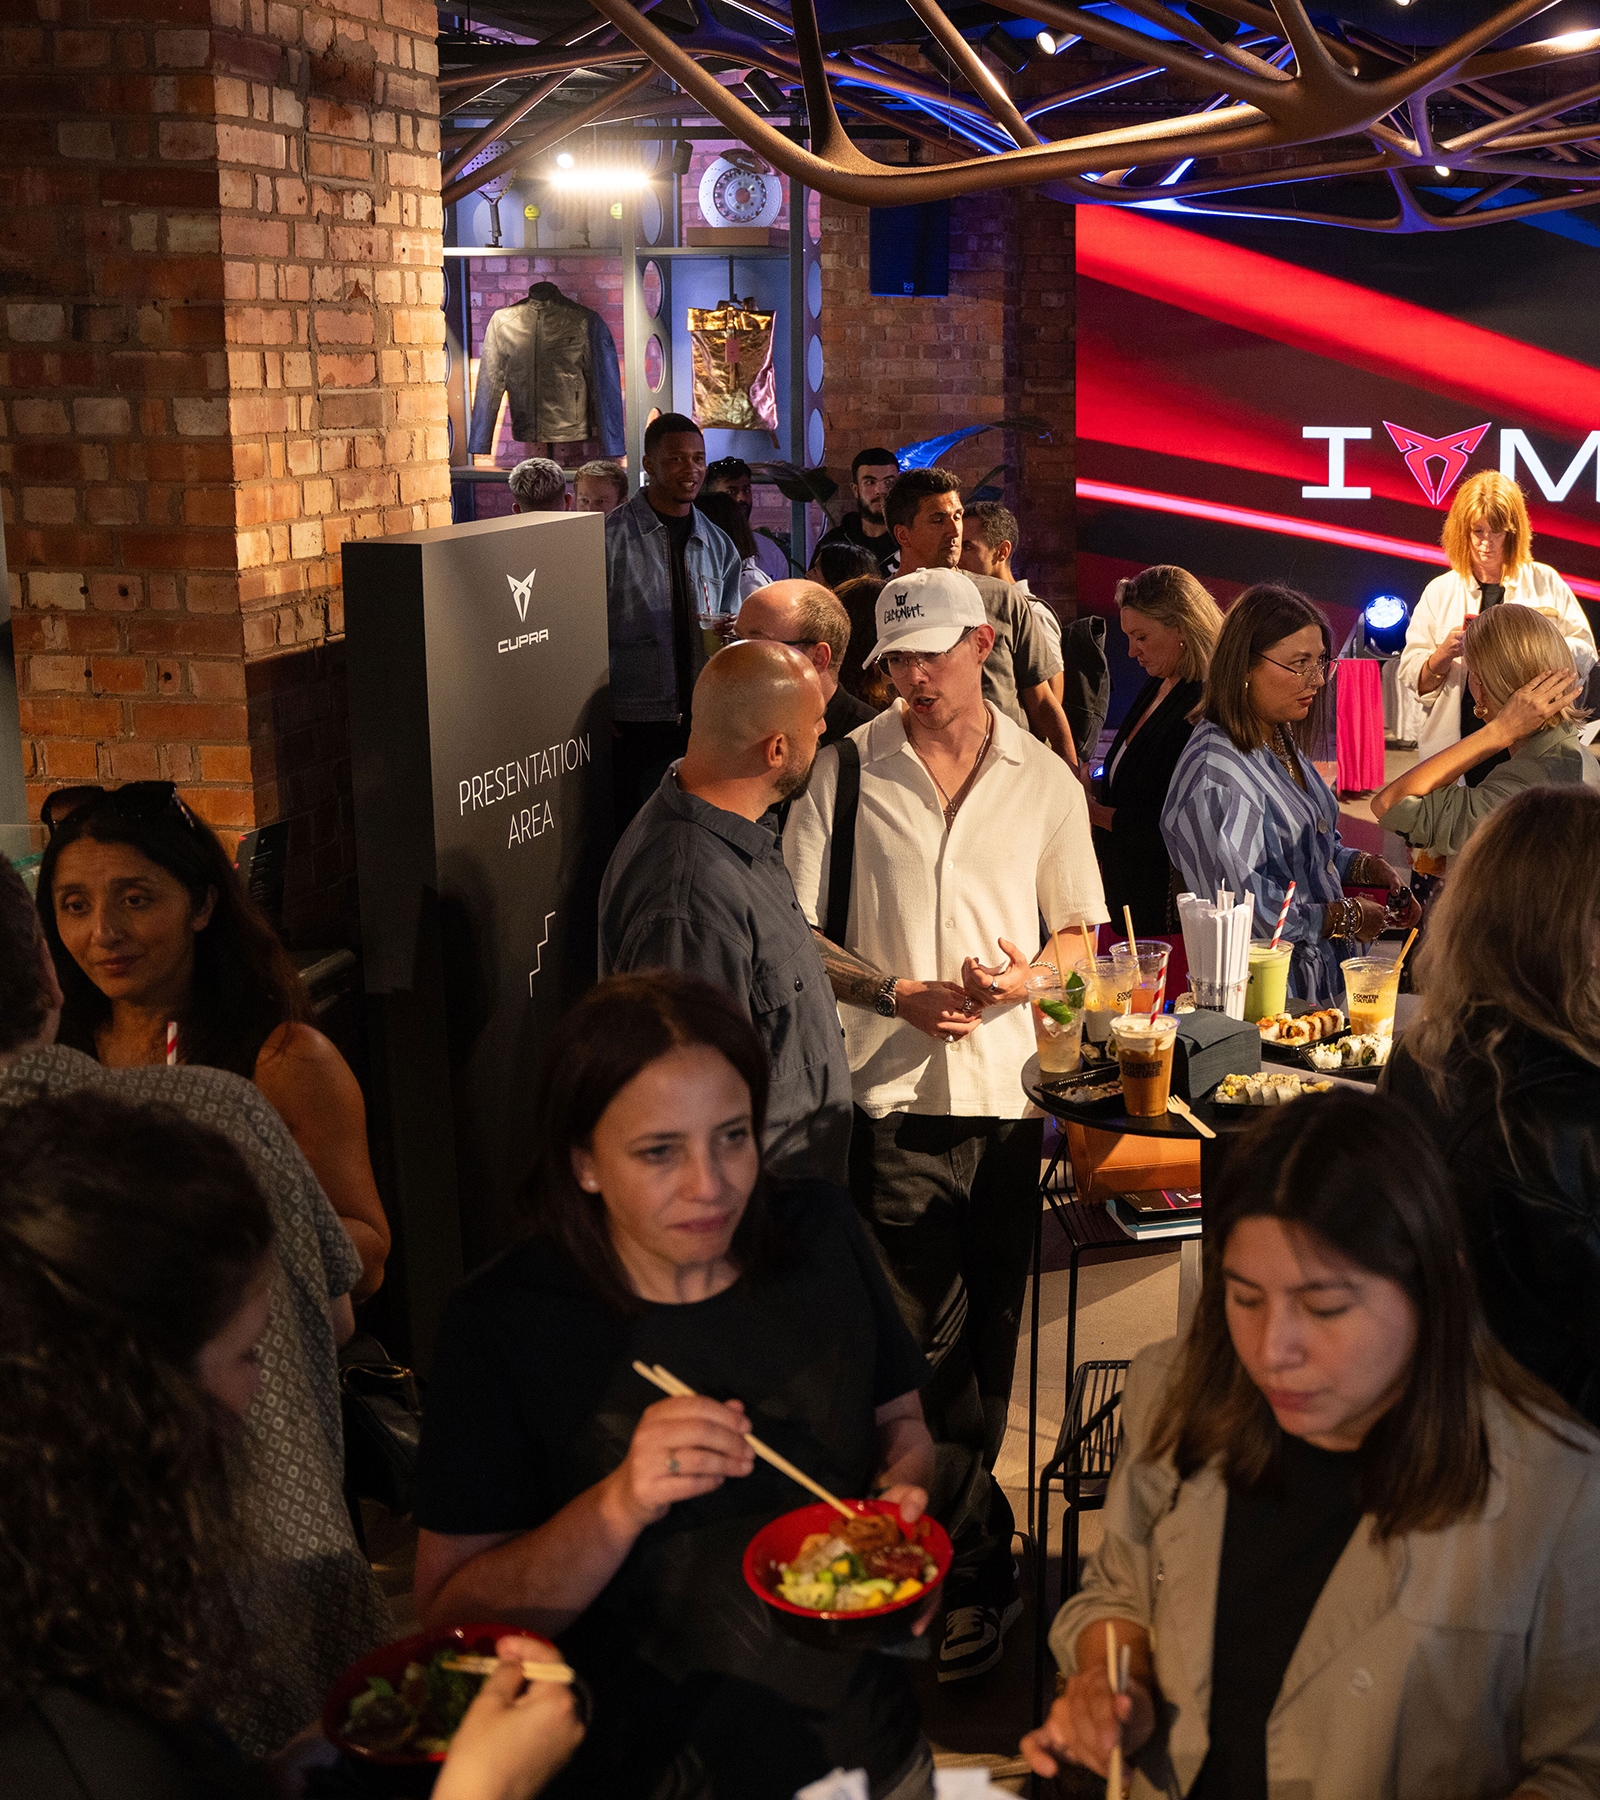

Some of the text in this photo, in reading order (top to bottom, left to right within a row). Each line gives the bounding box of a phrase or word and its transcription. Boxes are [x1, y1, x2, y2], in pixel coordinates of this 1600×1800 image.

[1302, 427, 1372, 499] I
[497, 628, 549, 654] CUPRA
[459, 733, 591, 816] PRESENTATION
[507, 799, 555, 849] AREA
[1352, 992, 1379, 1000] COUNTER
[1121, 1060, 1163, 1071] COUNTER
[1121, 1068, 1161, 1079] CULTURE
